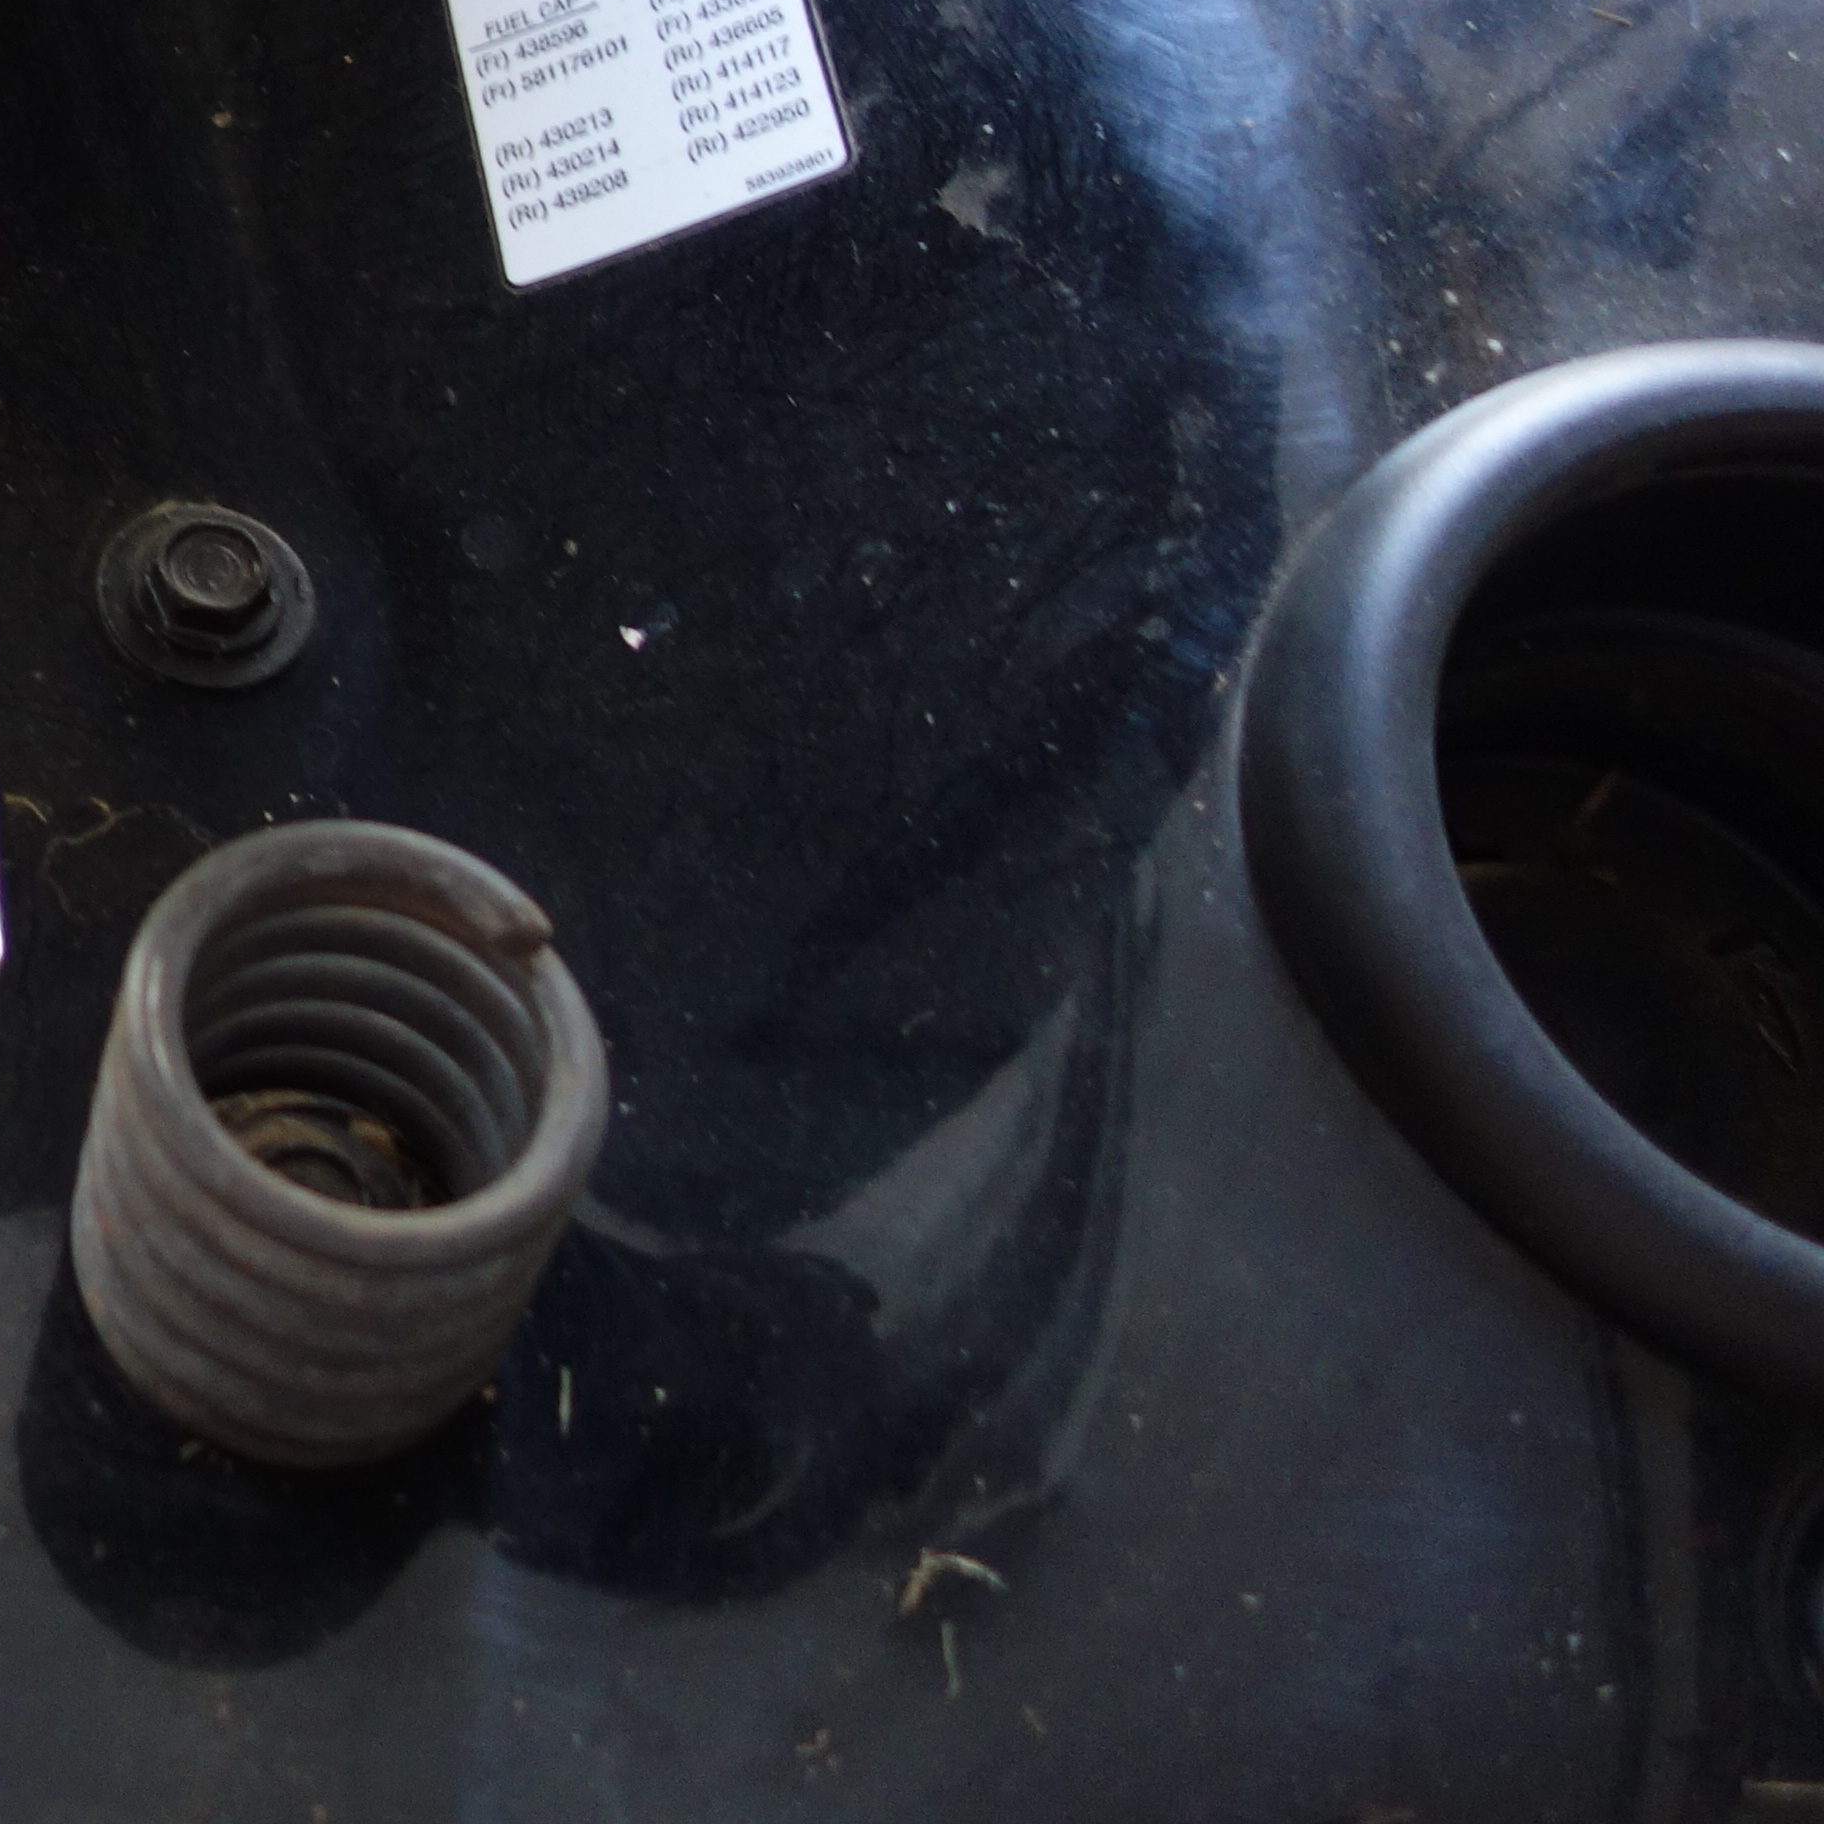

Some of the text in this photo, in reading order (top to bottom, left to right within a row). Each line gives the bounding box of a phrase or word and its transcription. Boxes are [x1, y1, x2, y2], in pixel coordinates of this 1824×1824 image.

[484, 9, 531, 41] FUEL
[655, 8, 692, 43] (Fr)
[475, 48, 510, 79] (Fr)
[663, 38, 704, 72] (Rr)
[670, 34, 790, 103] (Rr) 414117
[481, 76, 517, 109] (Fr)
[678, 66, 802, 134] (Rr) 414123
[494, 107, 614, 170] (Rr) 430213
[686, 129, 728, 165] (Rr)
[501, 137, 621, 200] (Rr) 430214
[508, 198, 549, 231] (Rr)
